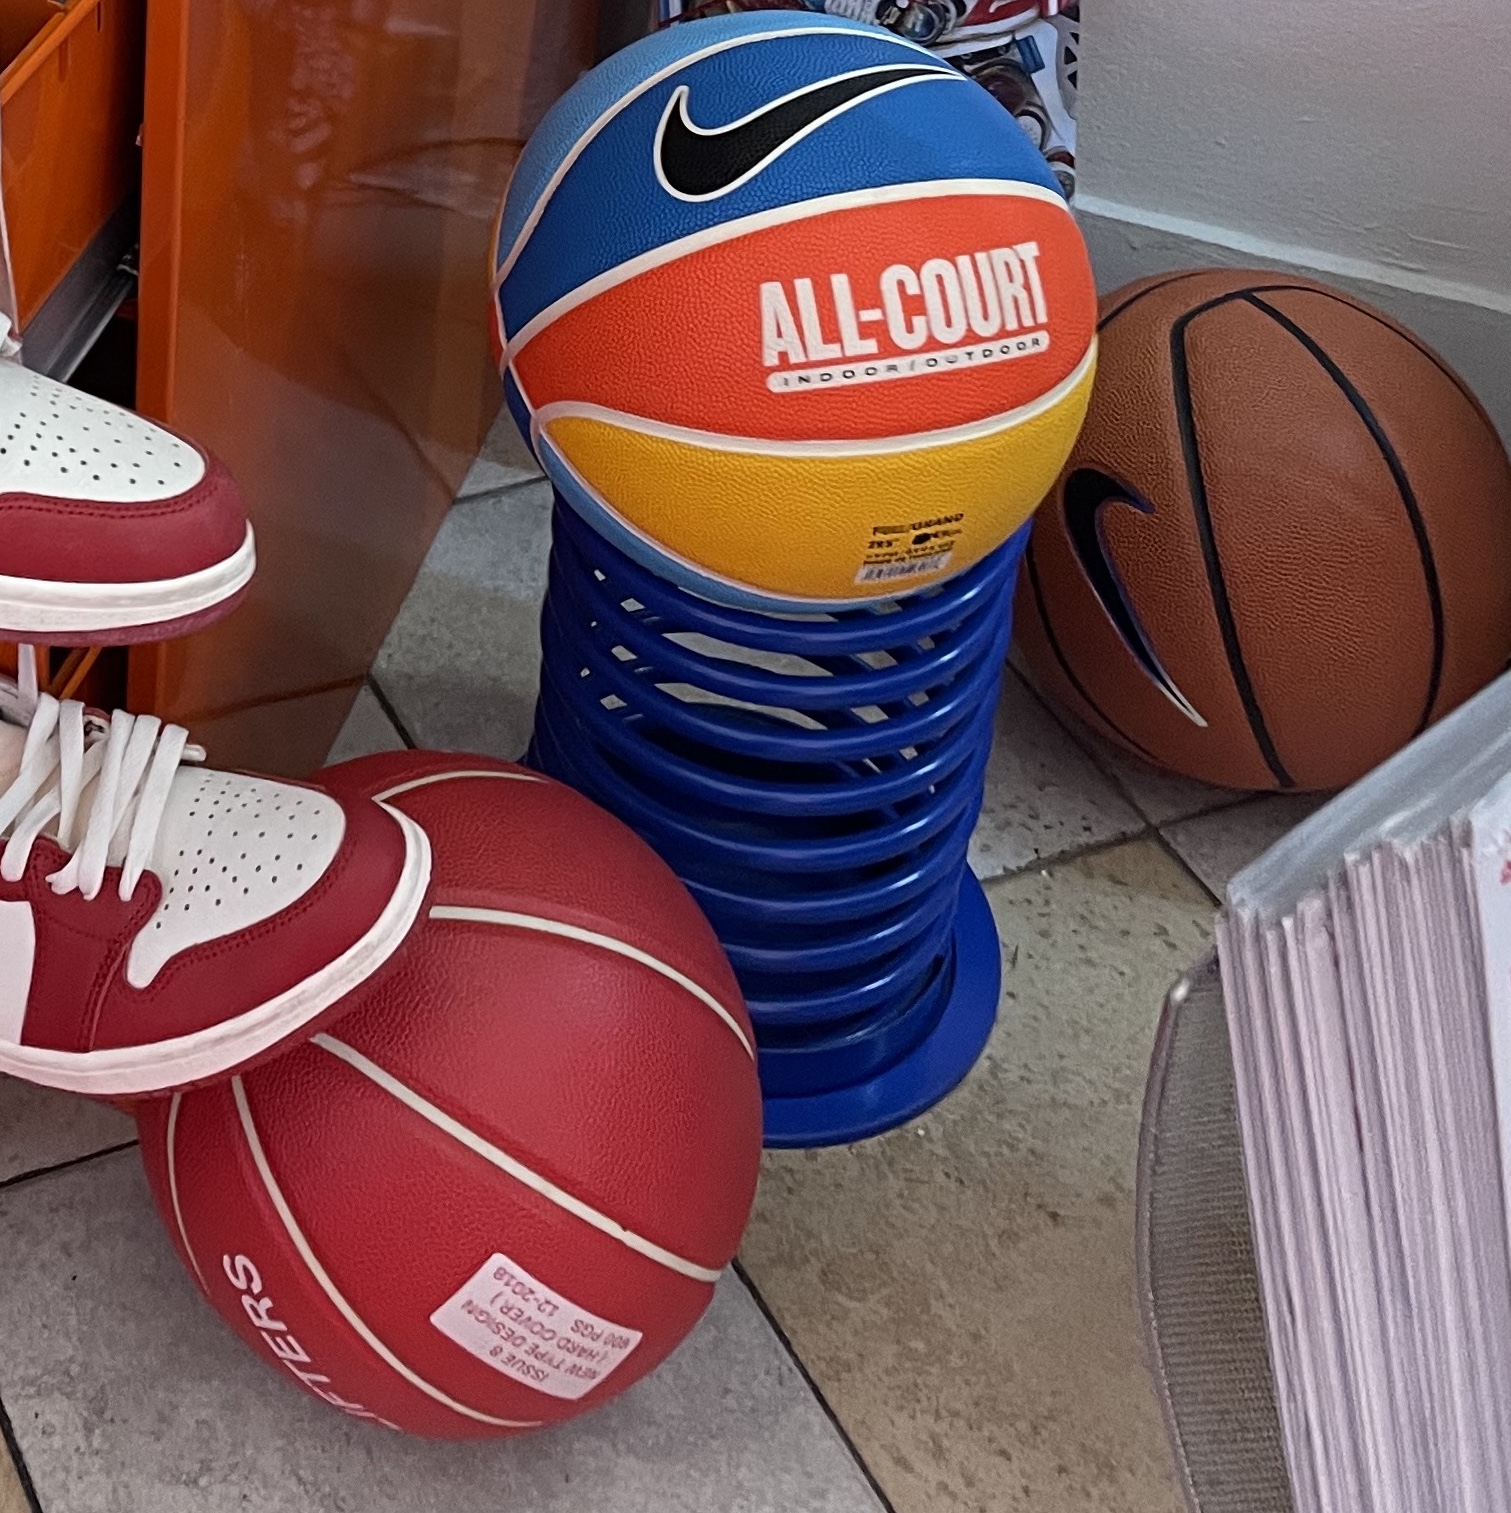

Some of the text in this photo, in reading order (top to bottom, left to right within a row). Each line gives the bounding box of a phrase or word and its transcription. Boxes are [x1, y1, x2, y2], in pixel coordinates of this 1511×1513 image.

[759, 241, 1048, 367] ALL-COURT
[493, 1266, 560, 1317] 12-2018
[461, 1299, 527, 1348] DESIGN
[570, 1319, 604, 1341] PGS
[501, 1352, 550, 1383] ISSUE
[524, 1342, 566, 1370] TYPE
